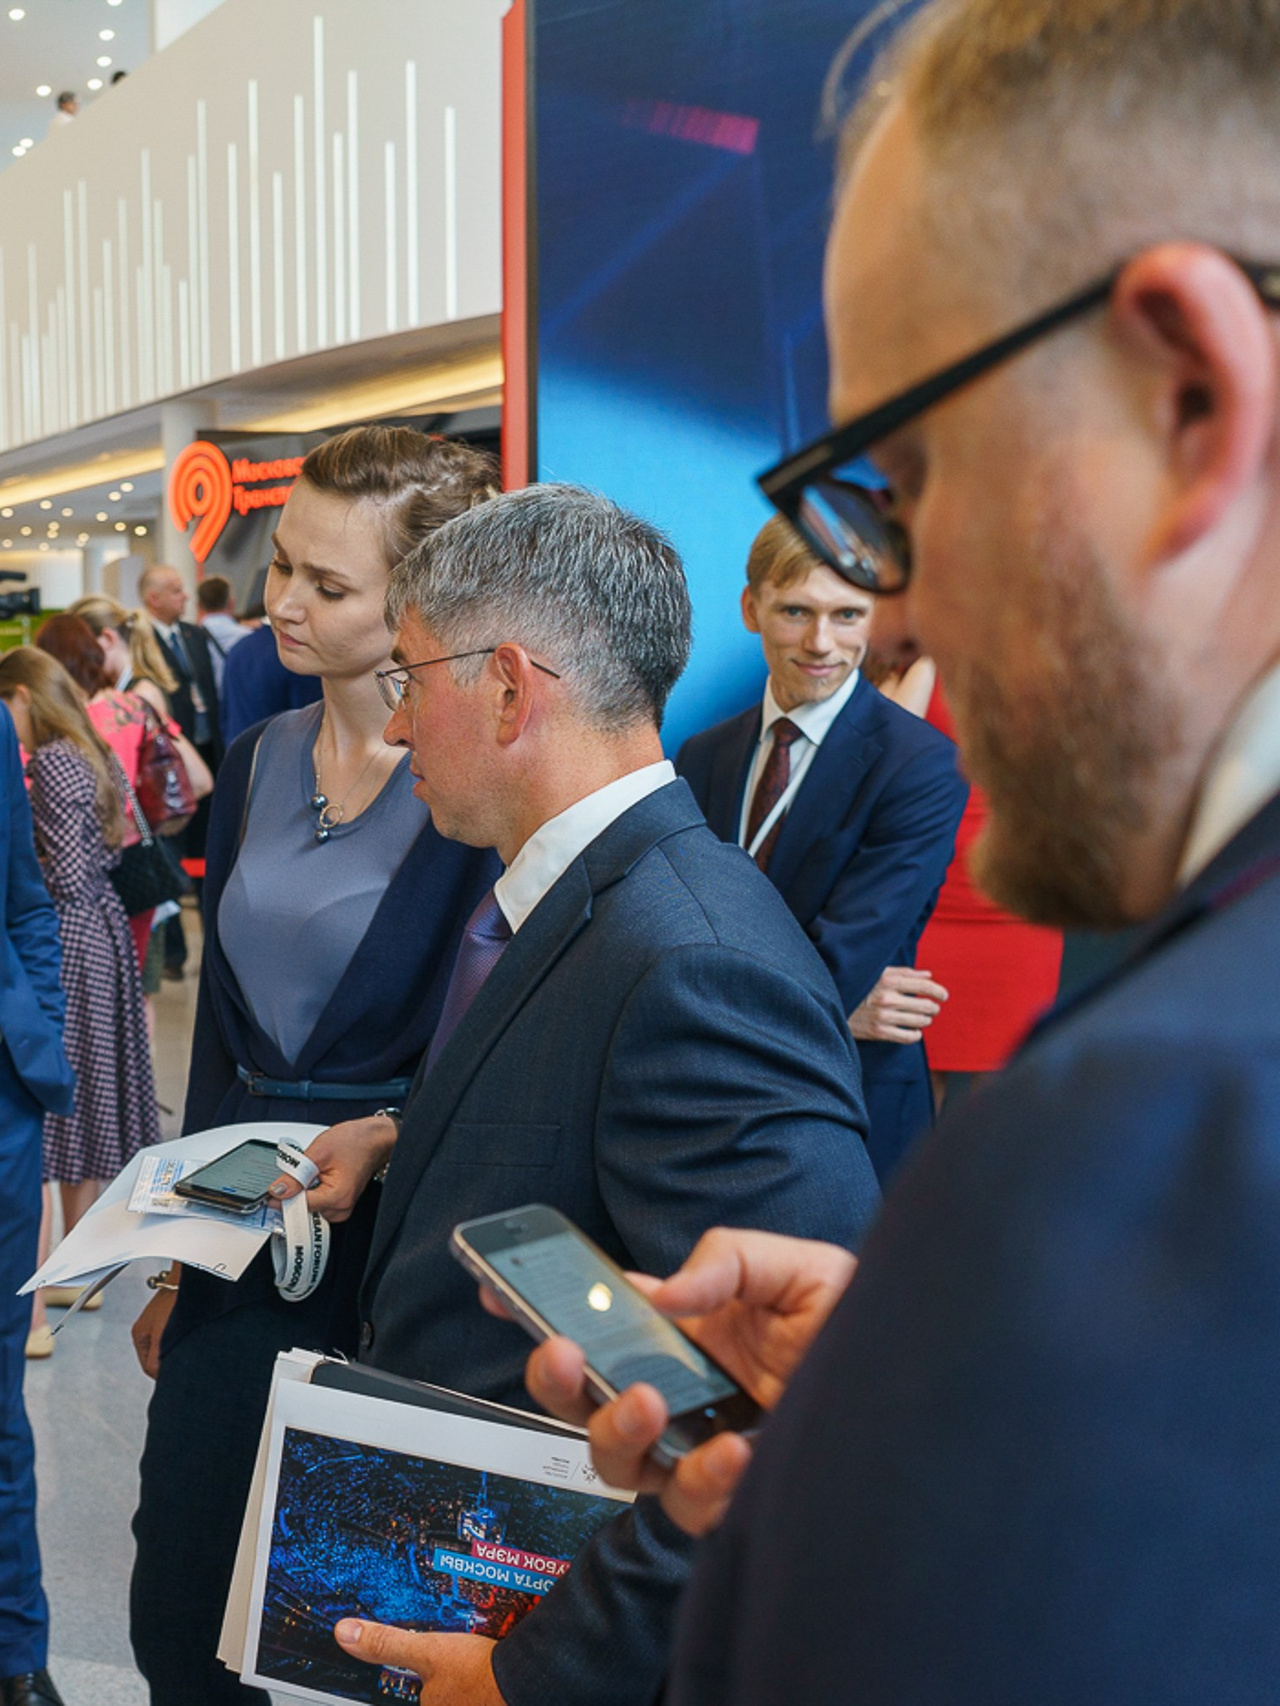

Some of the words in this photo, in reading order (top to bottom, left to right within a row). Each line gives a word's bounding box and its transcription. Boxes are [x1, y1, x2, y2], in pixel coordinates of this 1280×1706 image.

[310, 1244, 322, 1283] FORUM
[476, 1543, 520, 1566] МЭРА
[523, 1556, 570, 1576] УБОК
[440, 1554, 510, 1582] МОСКВЫ
